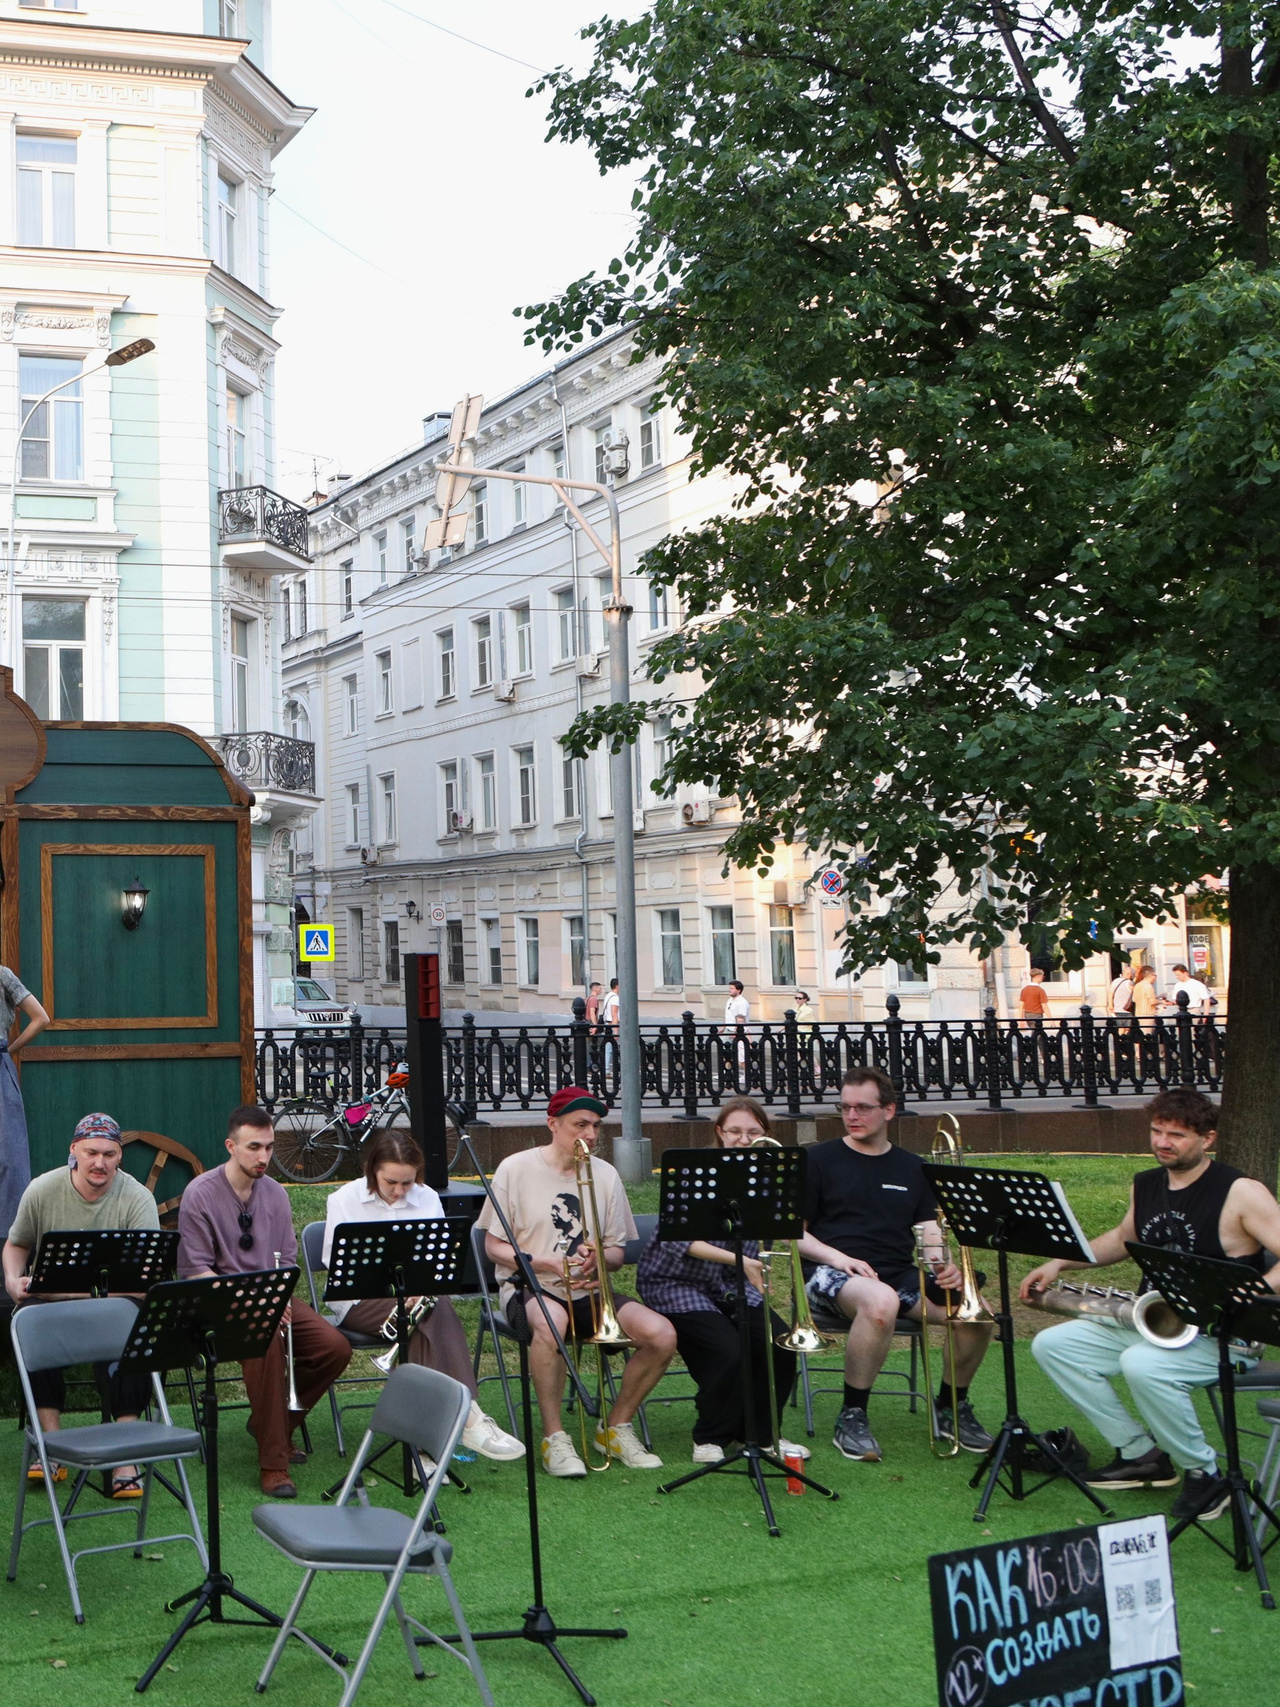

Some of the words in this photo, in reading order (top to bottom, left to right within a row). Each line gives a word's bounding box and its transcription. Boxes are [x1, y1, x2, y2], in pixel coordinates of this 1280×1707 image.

[1189, 935, 1209, 944] КОФЕ
[945, 1547, 1029, 1640] КАК
[1026, 1537, 1101, 1607] 16:00
[984, 1606, 1102, 1686] СОЗДАТЬ
